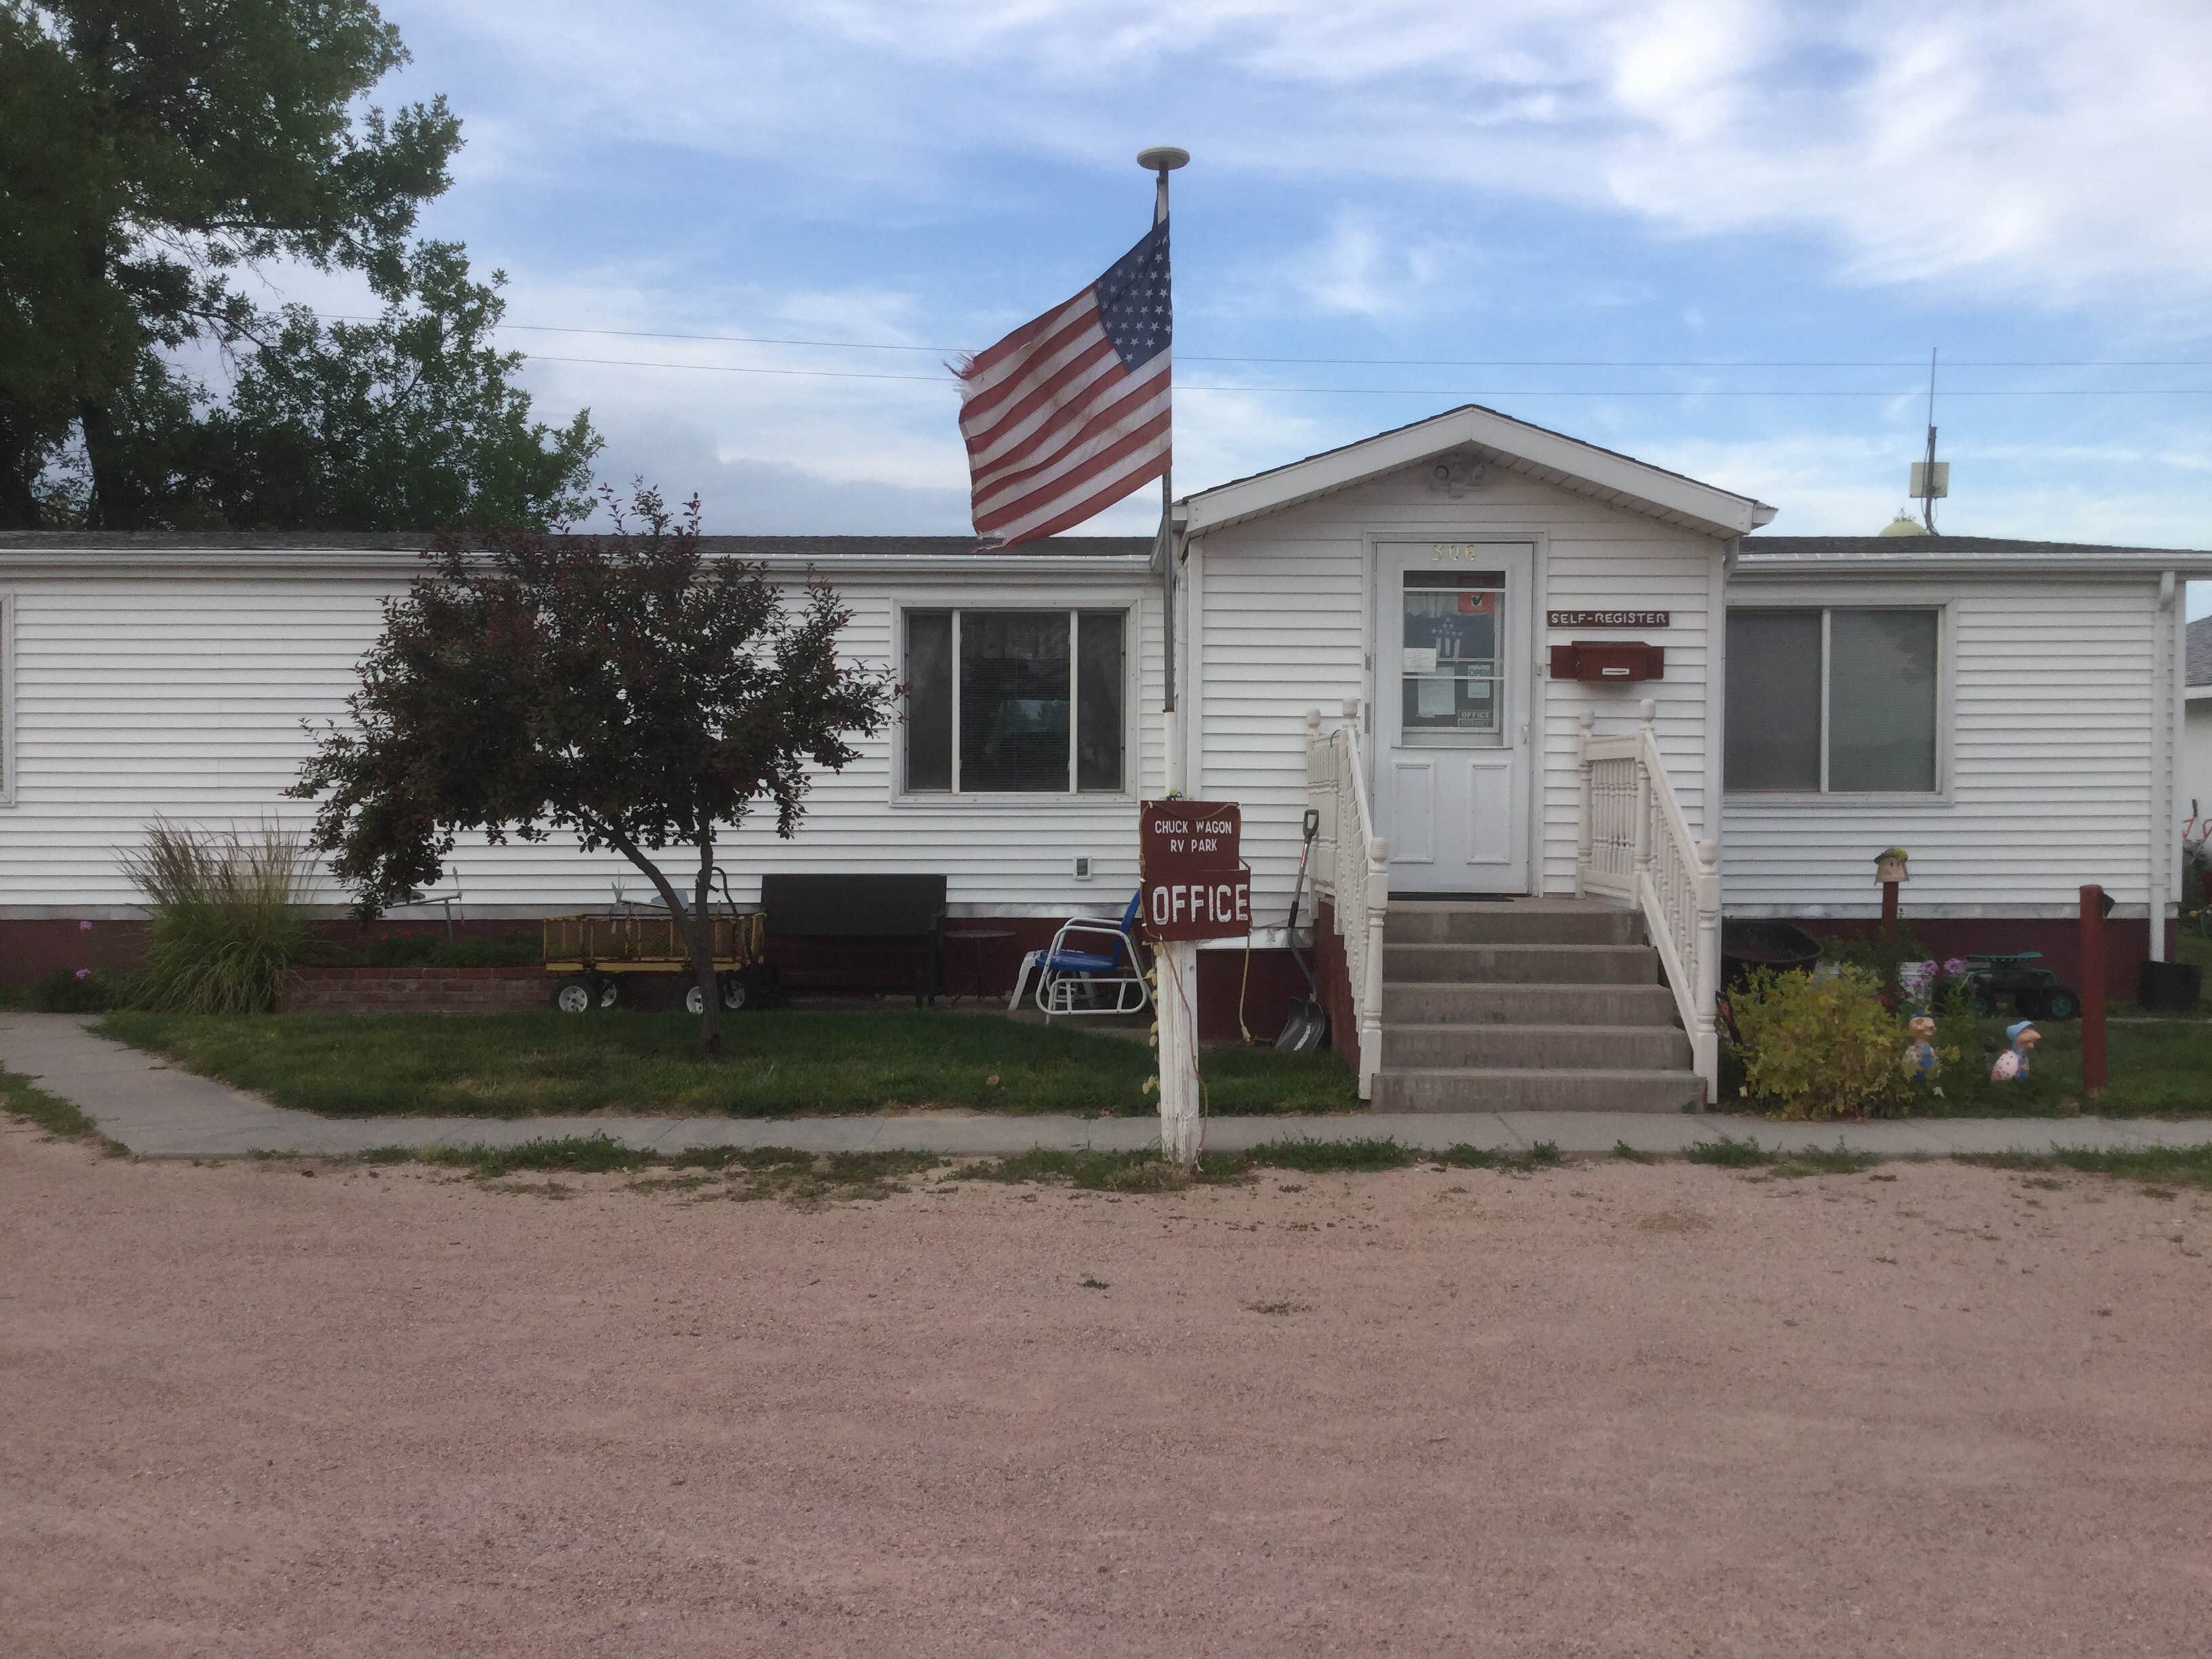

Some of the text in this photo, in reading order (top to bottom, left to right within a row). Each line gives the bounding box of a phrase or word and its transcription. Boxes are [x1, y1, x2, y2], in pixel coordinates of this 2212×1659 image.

[1431, 545, 1476, 562] 306
[1551, 613, 1666, 623] SELF-REGISTER
[1469, 668, 1490, 677] OPEN
[1155, 821, 1231, 834] CHUCK WAGON
[1170, 839, 1217, 852] RV PARK
[1153, 884, 1248, 925] OFFICE
